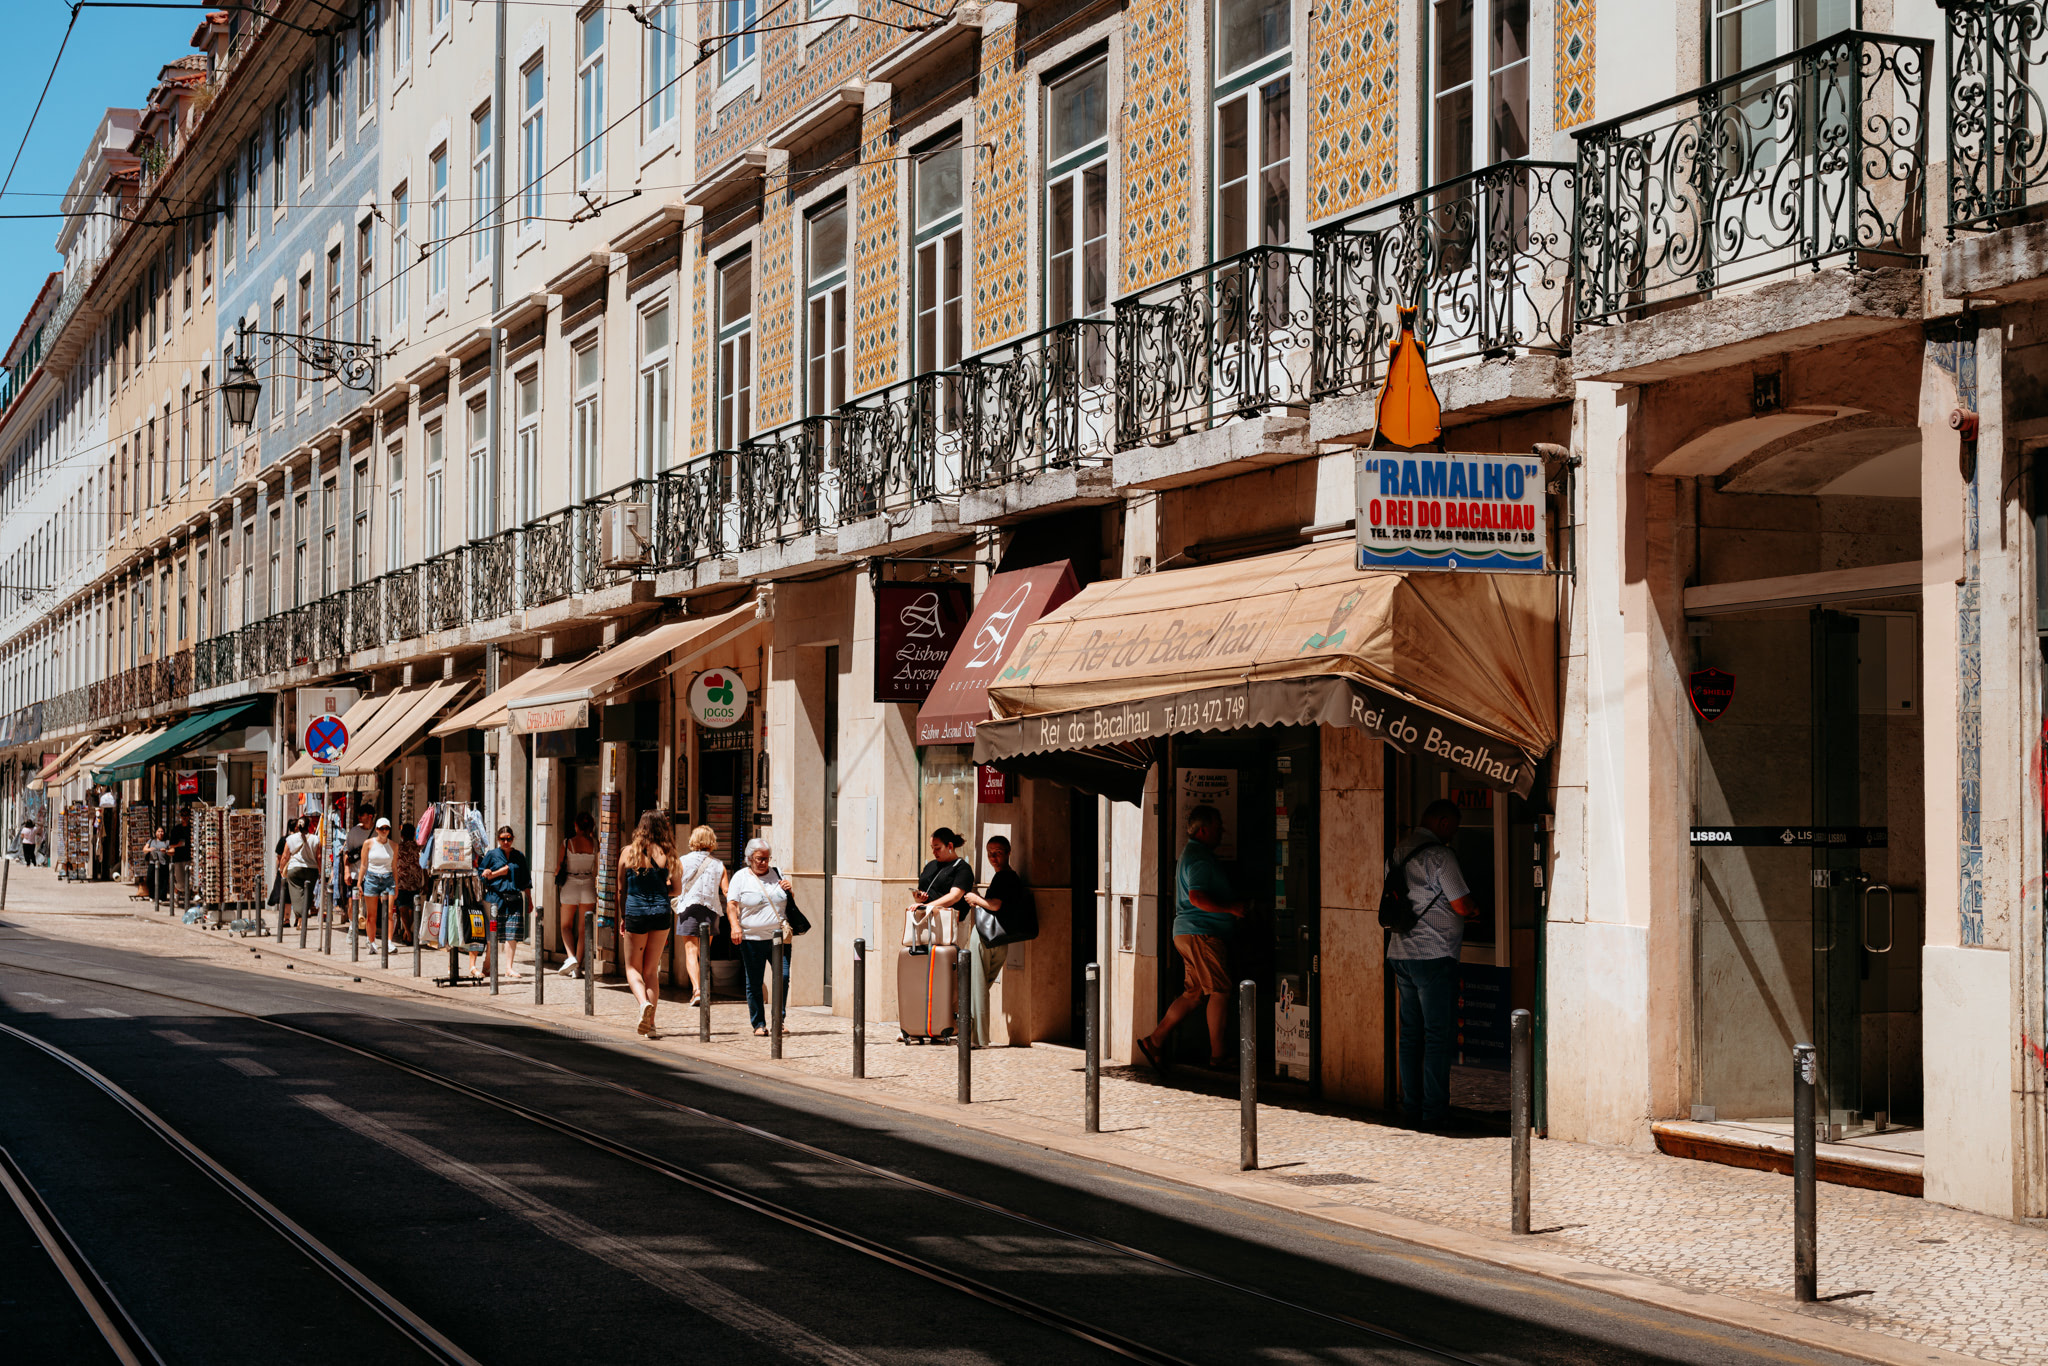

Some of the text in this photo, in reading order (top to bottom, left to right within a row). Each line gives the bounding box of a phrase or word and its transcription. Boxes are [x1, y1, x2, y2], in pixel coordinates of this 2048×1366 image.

[1365, 459, 1538, 500] “RAMALHO”
[1370, 499, 1535, 530] O REI DO BACALHAU
[1370, 528, 1390, 539] TEL.
[1393, 528, 1411, 540] 213
[1413, 529, 1432, 540] 472
[1435, 530, 1453, 541] 749
[1455, 530, 1495, 542] PORTAS
[1497, 531, 1511, 542] 56
[1521, 532, 1535, 543] 58
[1068, 610, 1267, 672] Rei do Bacalhau
[895, 642, 949, 661] Lisbon
[892, 661, 942, 681] Arsen
[893, 683, 931, 691] SUIT
[948, 678, 990, 692] SUITES
[1702, 688, 1732, 696] SHIELD
[703, 707, 734, 720] JOGOS
[1040, 695, 1245, 746] Rei do Bacalhau Tel 213 472 749
[920, 723, 940, 741] Lisbon
[941, 721, 963, 739] Arsenal
[1350, 694, 1519, 785] Rei do Bacalhau
[1457, 790, 1487, 808] ATM
[1690, 831, 1812, 842] LISBOA LIS
